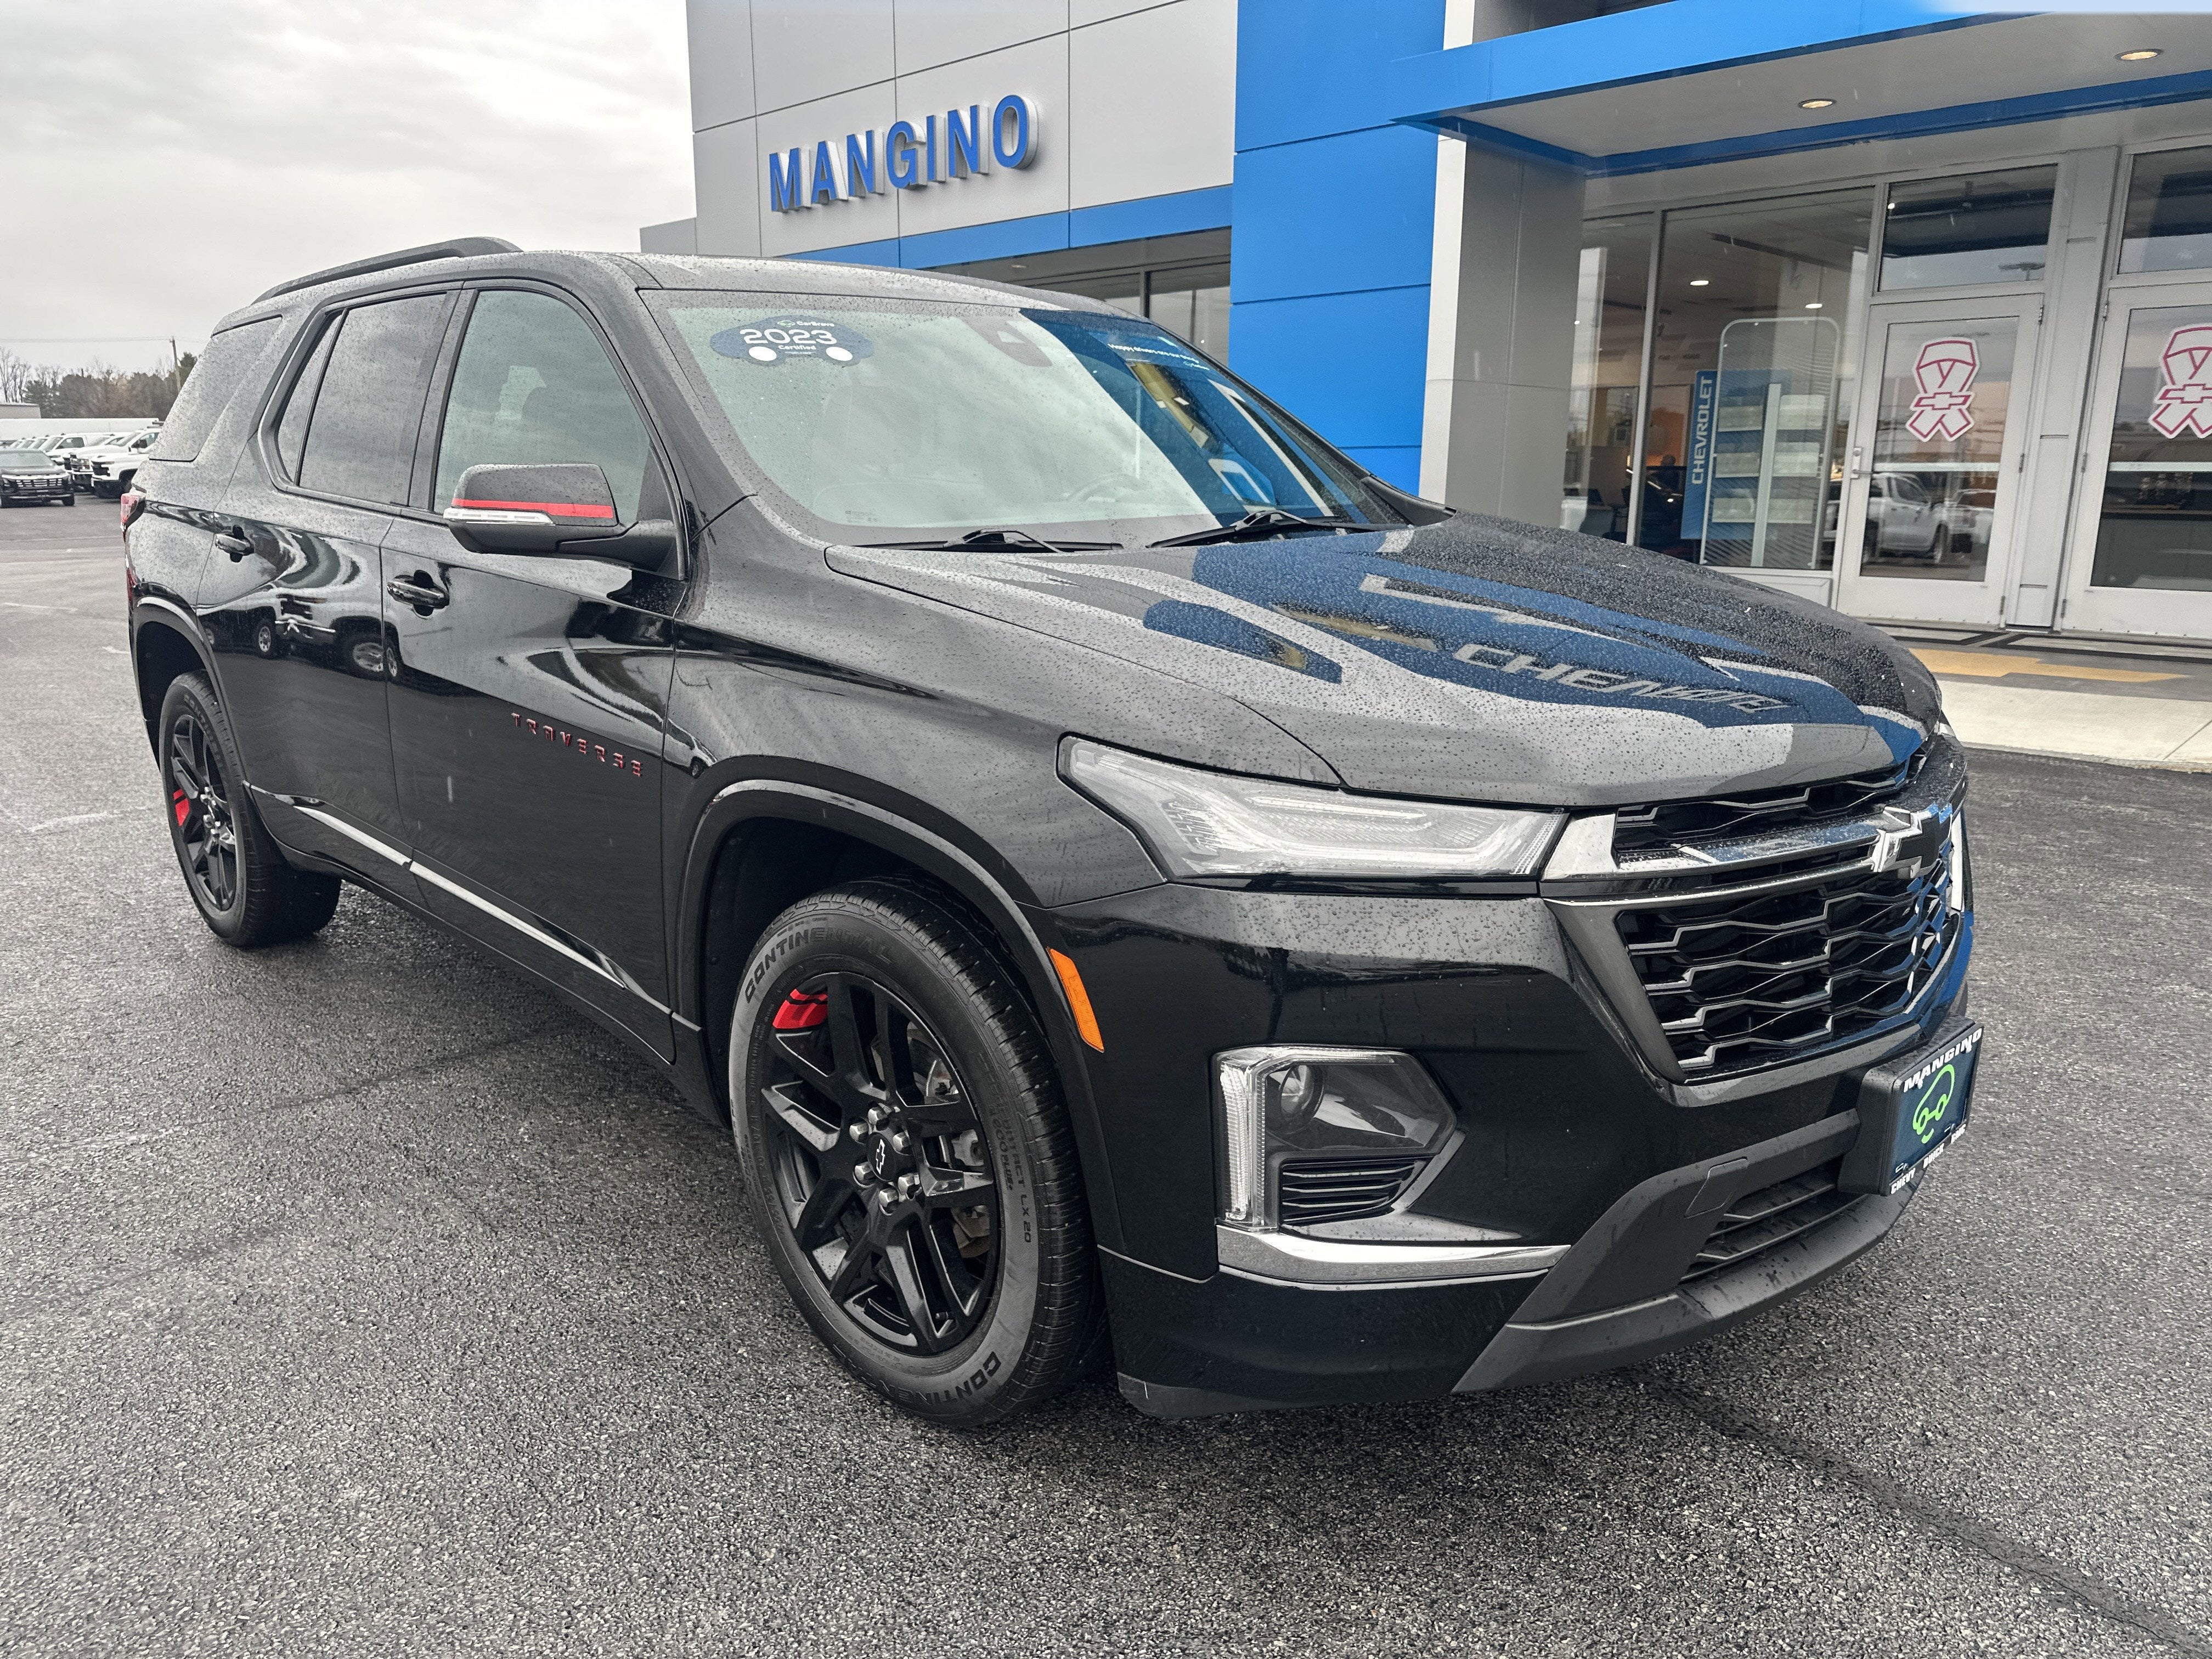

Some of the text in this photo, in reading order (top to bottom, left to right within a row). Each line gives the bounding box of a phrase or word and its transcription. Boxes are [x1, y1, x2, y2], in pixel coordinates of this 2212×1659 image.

[769, 94, 1035, 213] MANGINO
[740, 329, 837, 345] 2023
[1692, 376, 1713, 484] CHEVROLET
[511, 712, 642, 777] TRAVERSE
[744, 927, 896, 1004] CONTINENTAL
[1903, 1028, 1983, 1093] MANGINO
[1891, 1167, 1916, 1194] CHEVY
[1923, 1143, 1944, 1169] BUICK
[1020, 1193, 1030, 1217] LX
[1023, 1220, 1032, 1243] 20
